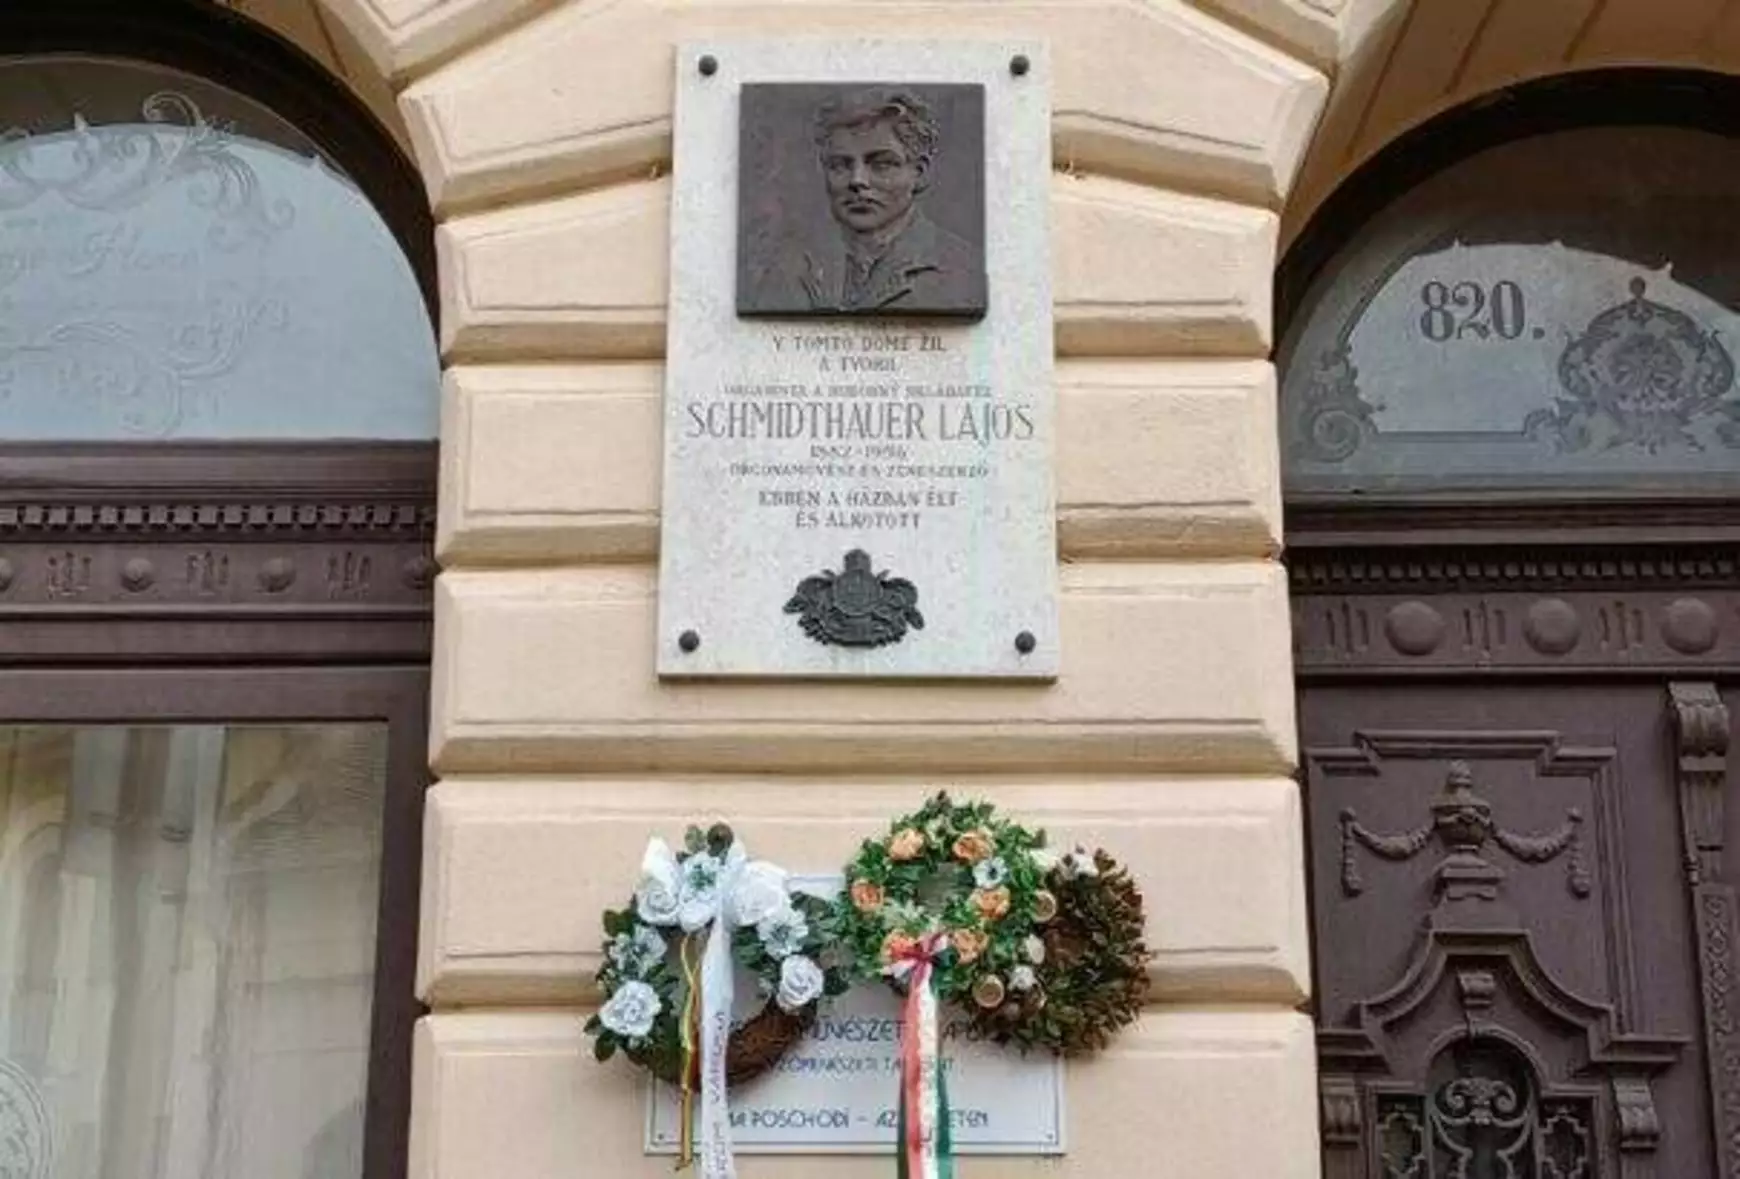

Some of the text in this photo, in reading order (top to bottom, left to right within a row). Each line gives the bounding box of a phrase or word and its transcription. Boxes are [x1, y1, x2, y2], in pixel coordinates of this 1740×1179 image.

[1419, 281, 1547, 342] 820.
[686, 402, 1035, 447] SCHMIDTHAUER LAJOS
